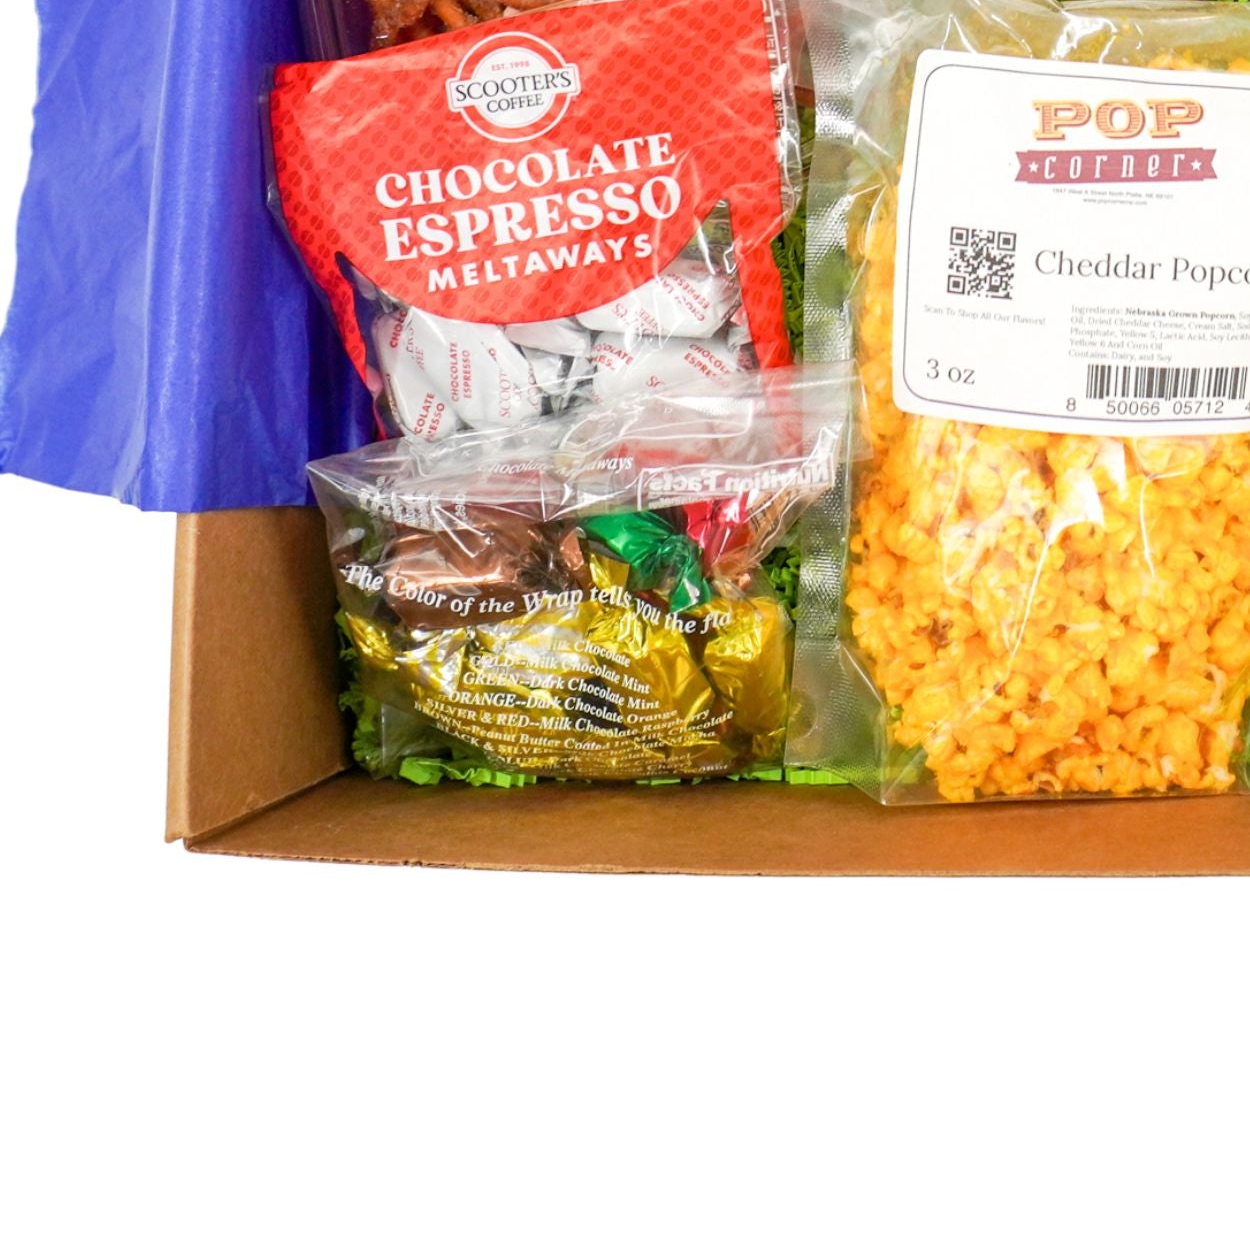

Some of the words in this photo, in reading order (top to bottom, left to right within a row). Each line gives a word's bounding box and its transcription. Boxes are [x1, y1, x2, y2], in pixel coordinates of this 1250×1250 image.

[455, 70, 572, 102] SCOOTER'S
[487, 94, 544, 113] COFFEE
[1032, 99, 1204, 141] POP
[375, 132, 676, 208] CHOCOLATE
[1044, 153, 1185, 179] corner
[380, 175, 681, 262] ESPRESSO
[428, 234, 653, 293] MELTAWAYS
[1034, 249, 1162, 280] Cheddar
[1125, 308, 1166, 317] Nebraska
[1169, 310, 1198, 319] Grown
[449, 342, 459, 402] CHOCOLATE
[462, 350, 472, 399] ESPRESSO
[926, 358, 939, 379] 3
[948, 366, 975, 385] oz
[1066, 397, 1077, 412] 8
[1106, 401, 1160, 415] 50066
[1173, 401, 1224, 414] 05712
[344, 565, 384, 591] The
[388, 575, 447, 609] Color
[451, 597, 476, 617] of
[479, 599, 515, 614] the
[522, 587, 583, 612] Wrap
[590, 585, 632, 609] tells
[634, 597, 661, 627] you
[664, 613, 697, 633] the
[561, 660, 620, 684] Chocolate
[622, 675, 650, 695] Mint
[567, 677, 625, 706] Chocolate
[627, 696, 660, 710] Mint
[426, 698, 477, 721] SILVER
[481, 713, 492, 724] &
[575, 718, 638, 738] Chocolate
[564, 697, 623, 724] Chocolate
[627, 710, 677, 724] Orange
[519, 733, 561, 748] Butter
[564, 738, 610, 750] Coated
